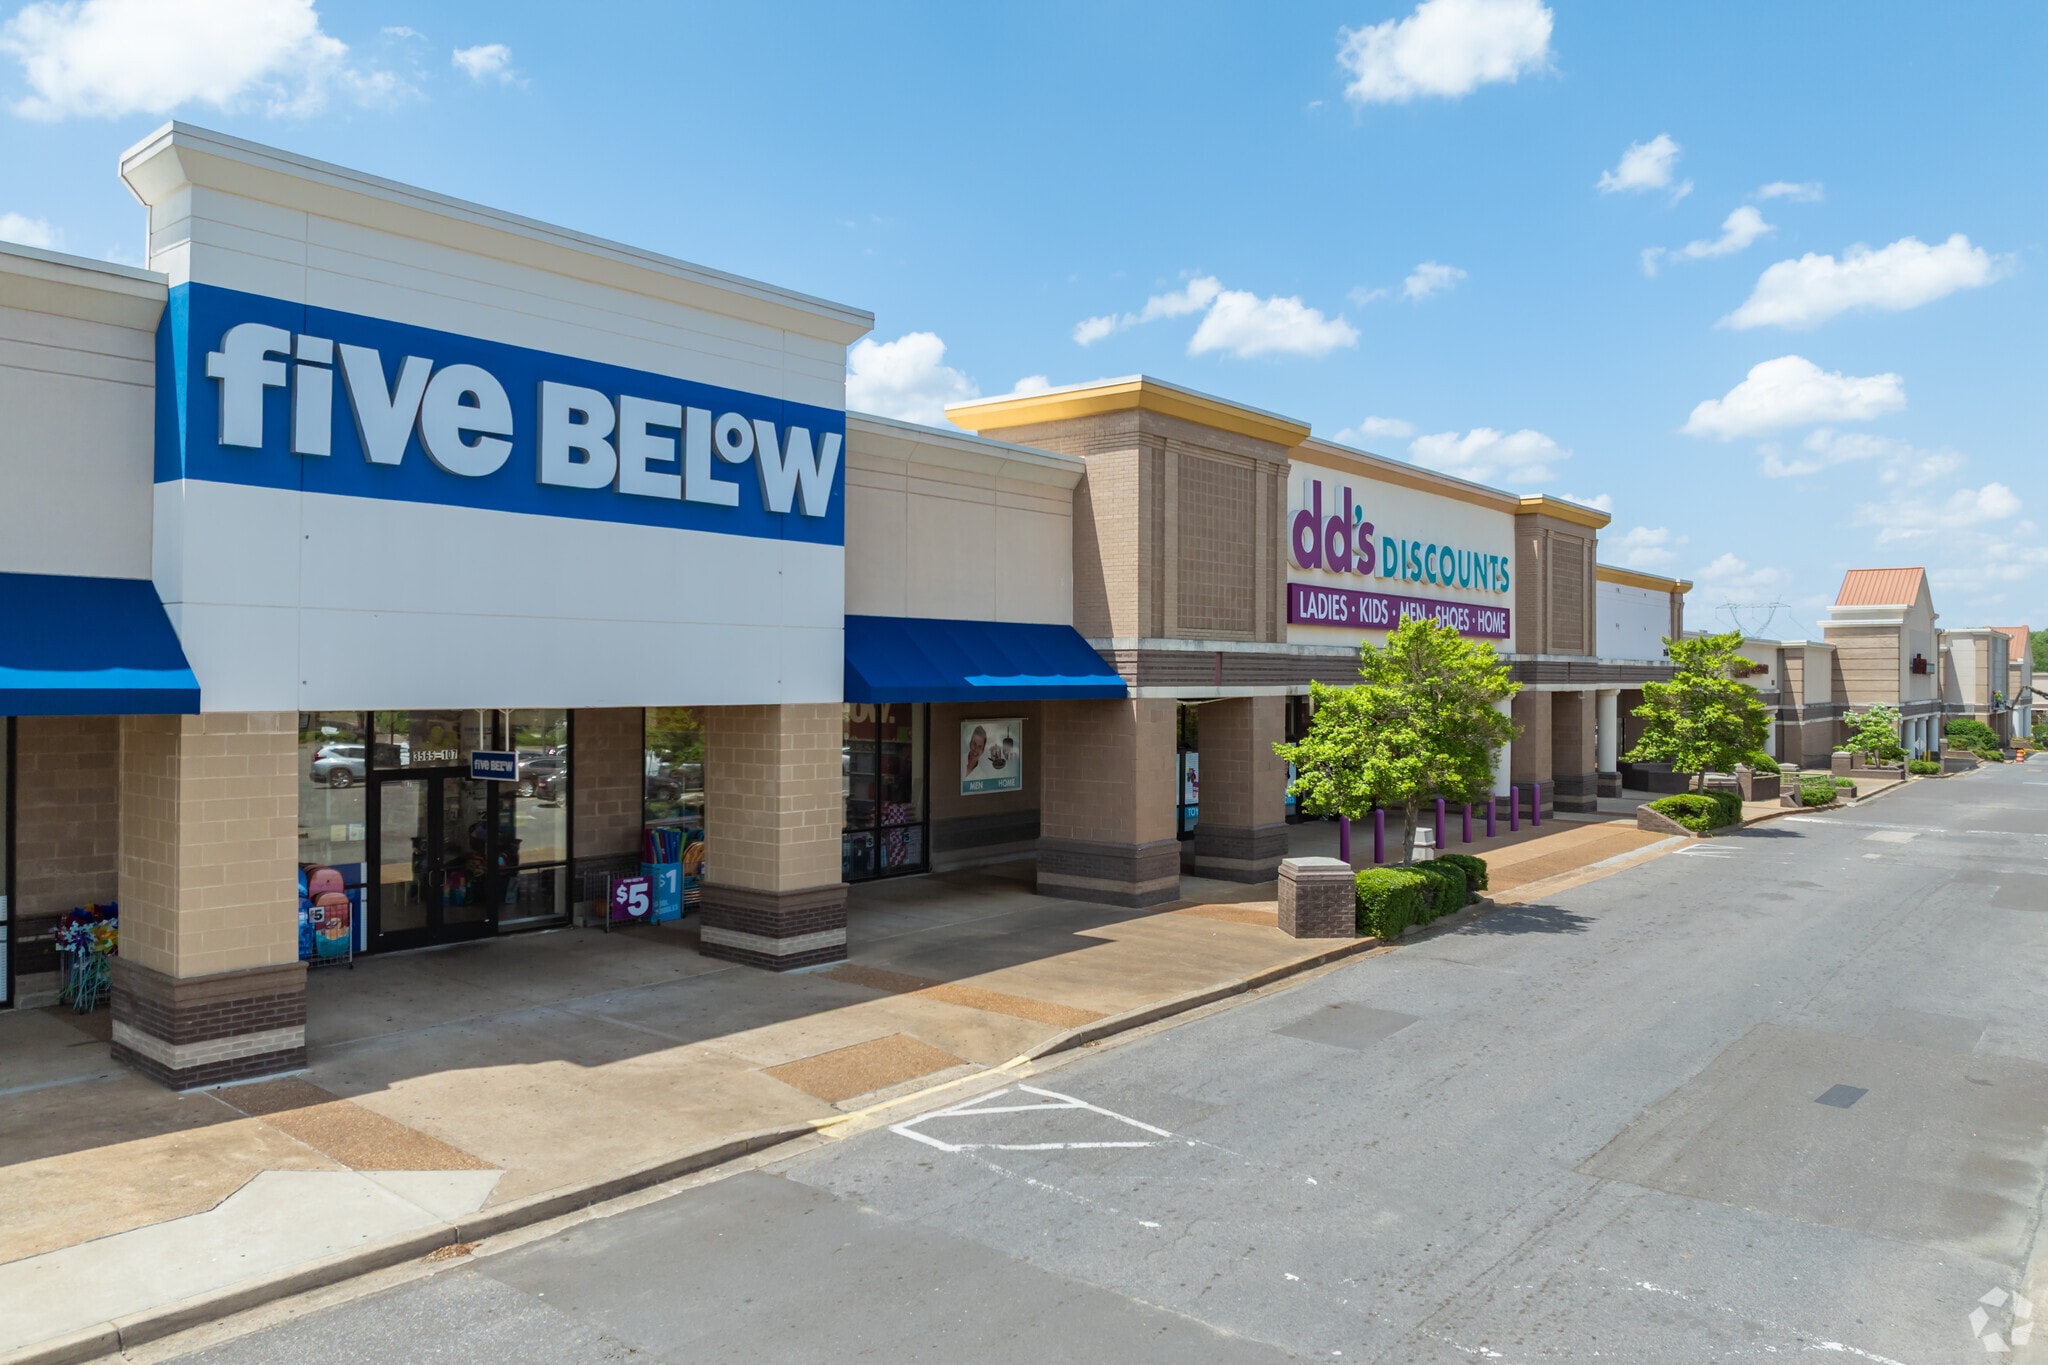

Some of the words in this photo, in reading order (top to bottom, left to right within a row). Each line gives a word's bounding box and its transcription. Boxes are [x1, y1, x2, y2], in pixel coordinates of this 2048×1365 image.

[206, 322, 514, 477] five
[1289, 479, 1376, 577] dd's
[1380, 536, 1510, 593] DISCOUNTS
[1300, 590, 1348, 621] LADIES
[1359, 597, 1389, 624] KIDS
[1400, 601, 1426, 623] MEN
[1435, 605, 1470, 631] SHOES
[1477, 609, 1506, 634] HOME
[474, 759, 490, 770] five
[969, 781, 984, 790] MEN
[998, 778, 1016, 788] HOME
[616, 882, 650, 917] $5
